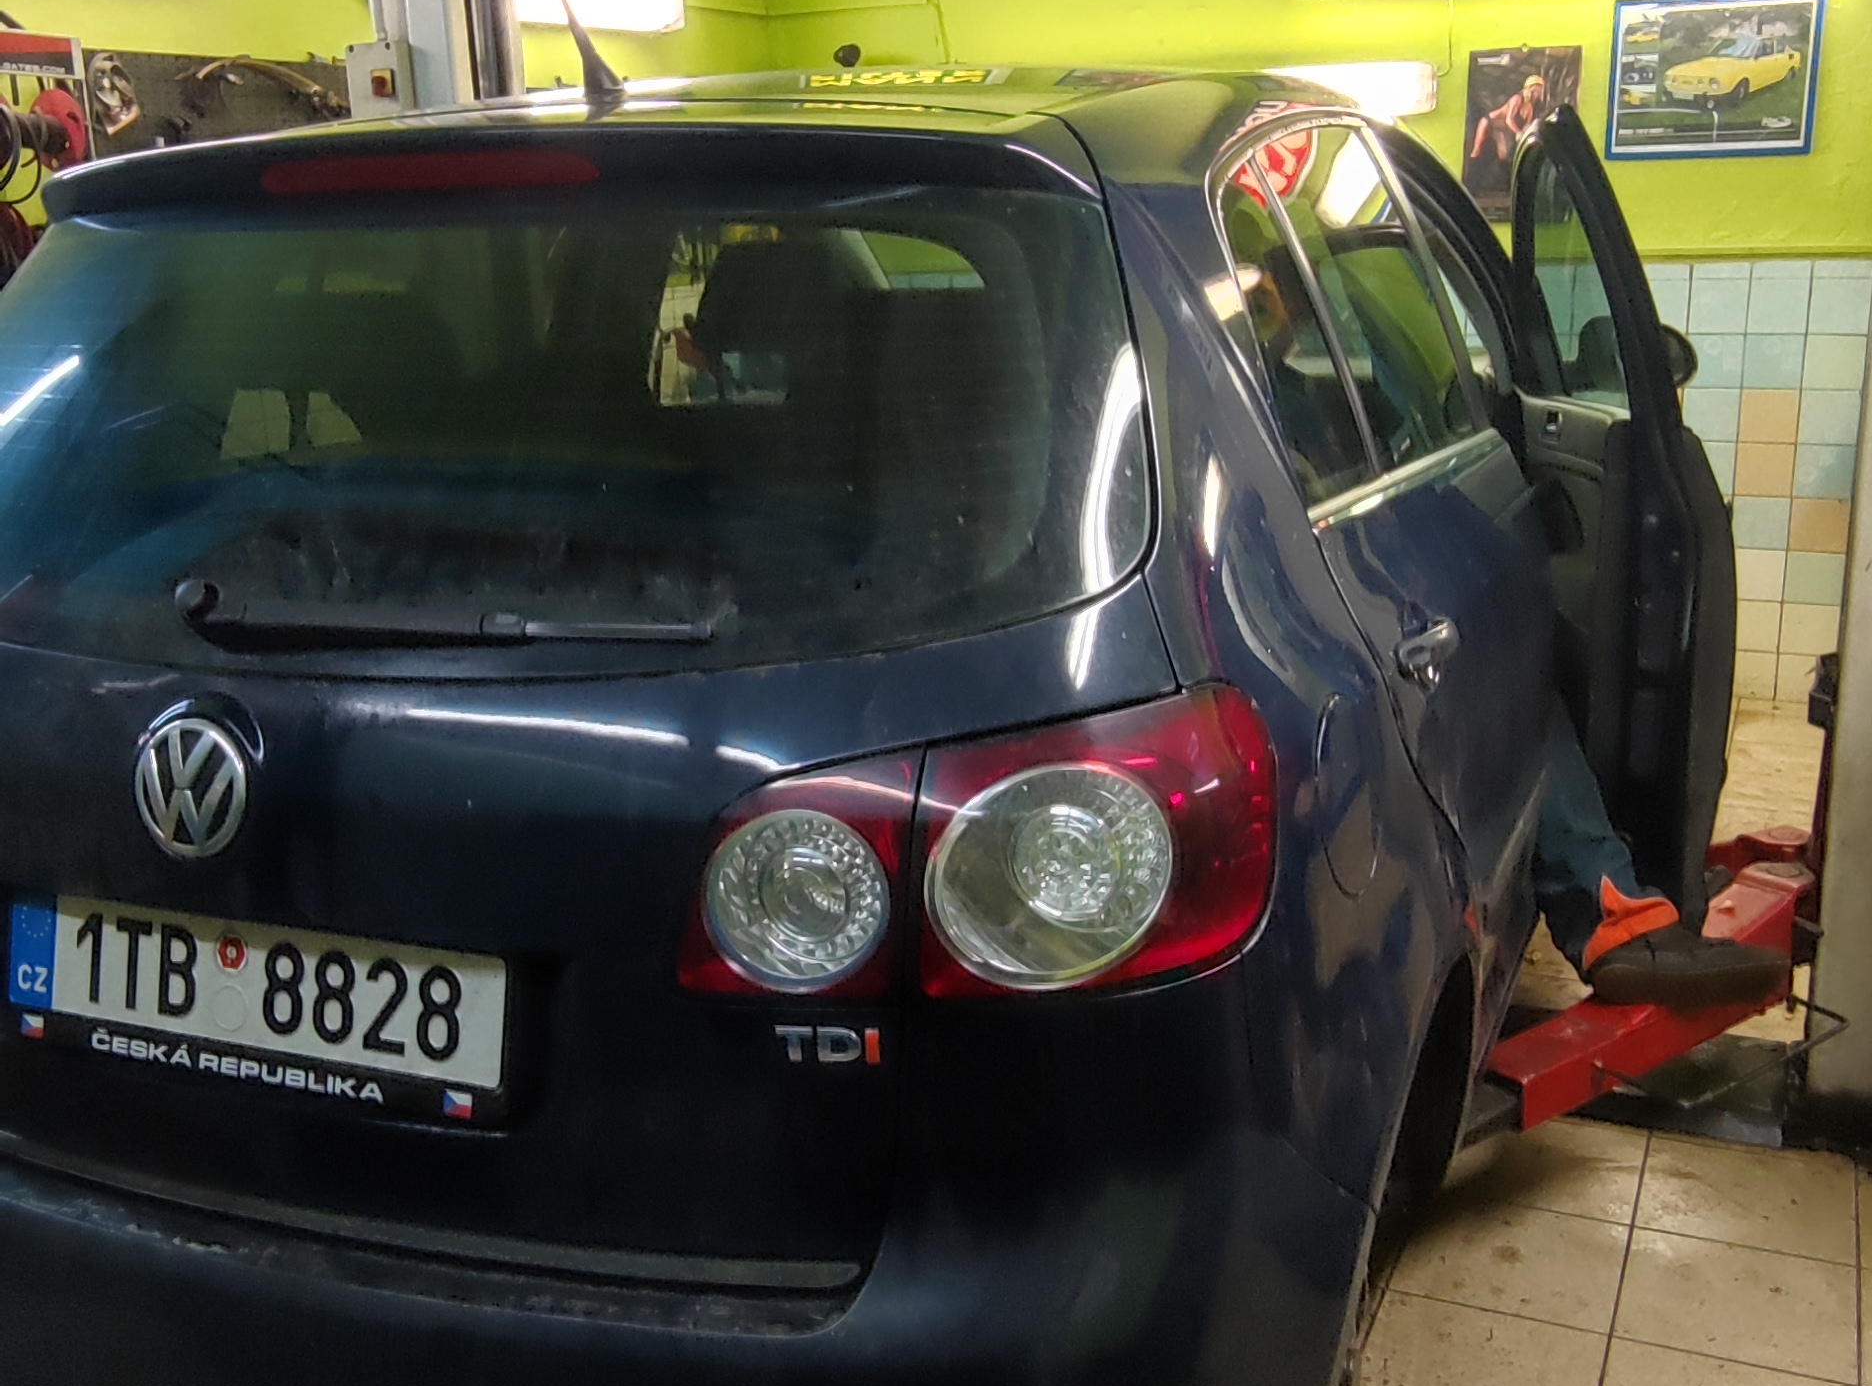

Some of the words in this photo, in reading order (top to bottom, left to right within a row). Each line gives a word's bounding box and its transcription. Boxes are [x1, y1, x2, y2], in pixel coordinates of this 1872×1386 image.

[17, 964, 48, 993] CZ
[77, 913, 197, 1017] 1TB
[262, 941, 461, 1061] 8828
[90, 1026, 192, 1068] ČESKÁ
[199, 1052, 384, 1104] REPUBLIKA
[773, 1024, 880, 1065] TDI
